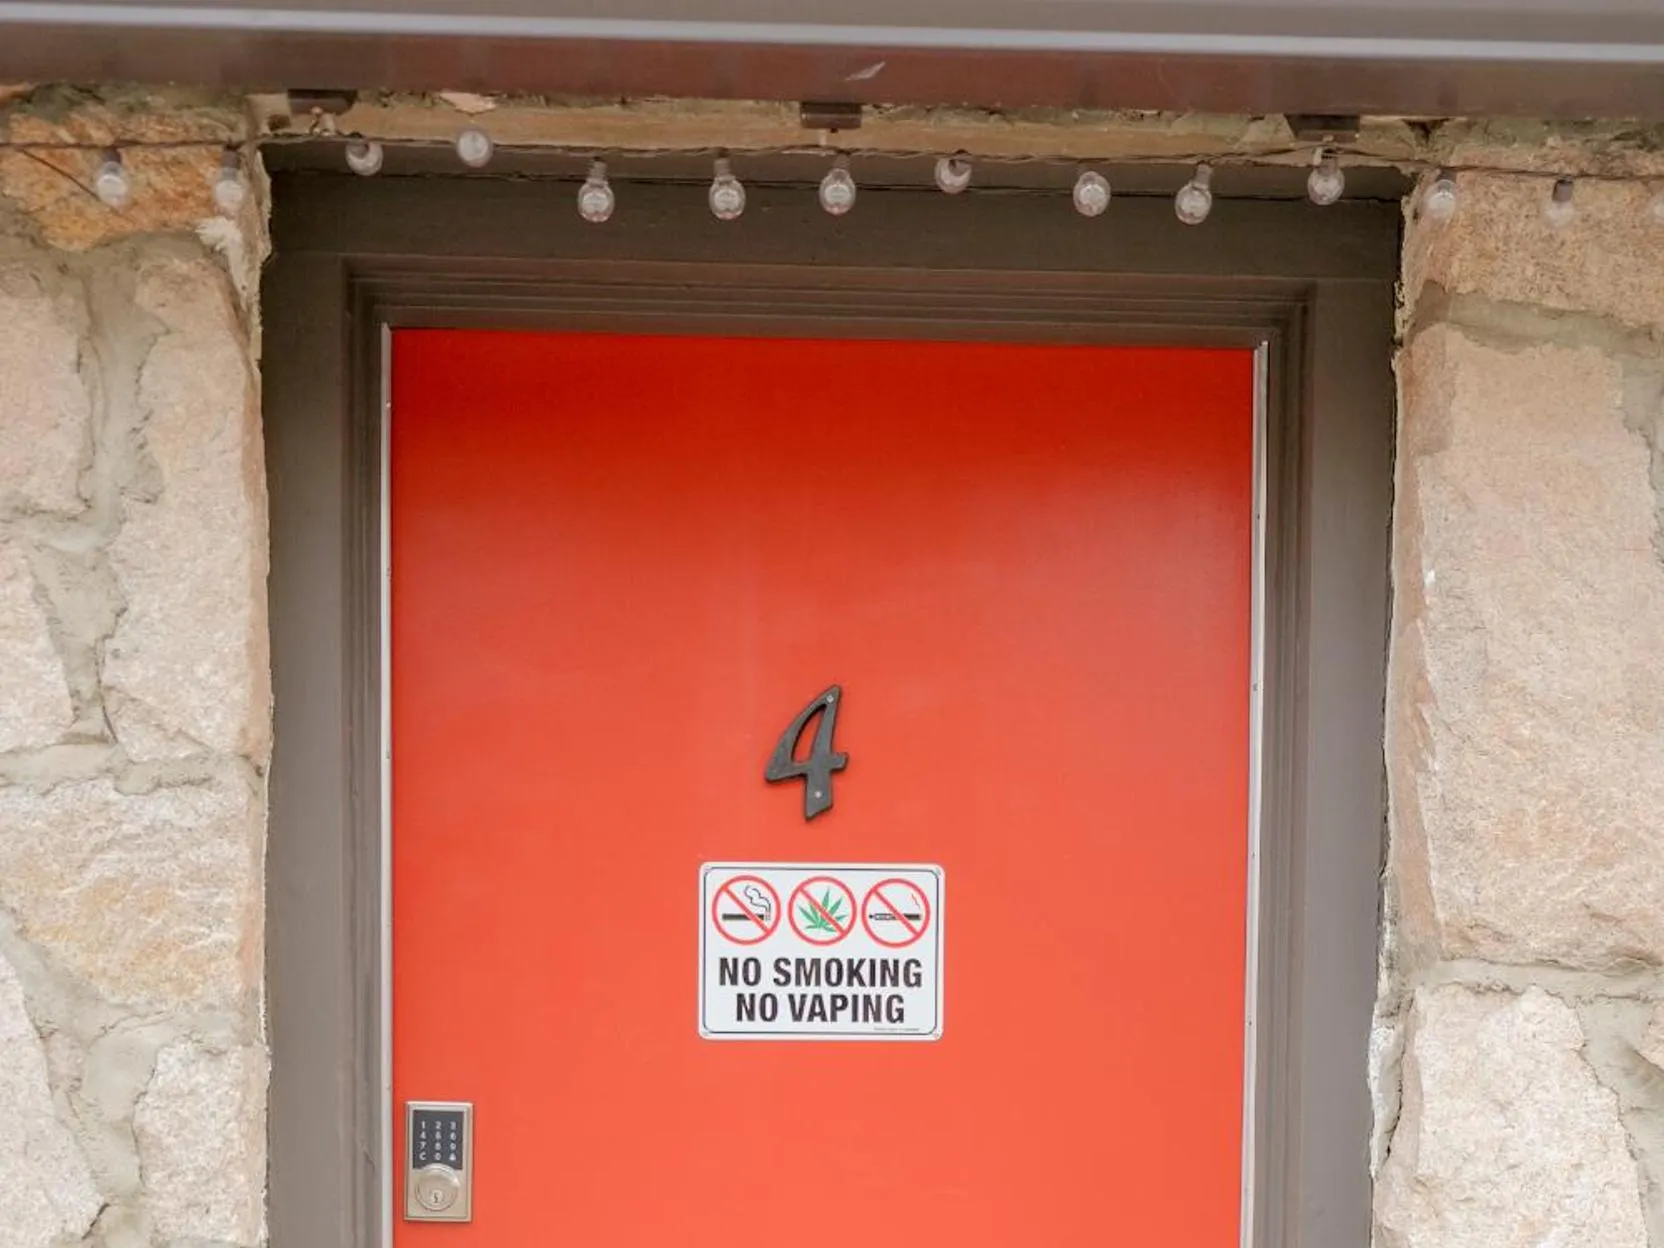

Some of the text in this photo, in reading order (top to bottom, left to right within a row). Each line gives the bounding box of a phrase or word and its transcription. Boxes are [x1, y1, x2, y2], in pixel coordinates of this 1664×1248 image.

[764, 685, 850, 823] 4
[719, 956, 923, 988] NO SMOKING
[736, 992, 905, 1024] NO VAPING
[419, 1131, 427, 1140] 4
[421, 1120, 426, 1129] 1
[434, 1120, 442, 1130] 2
